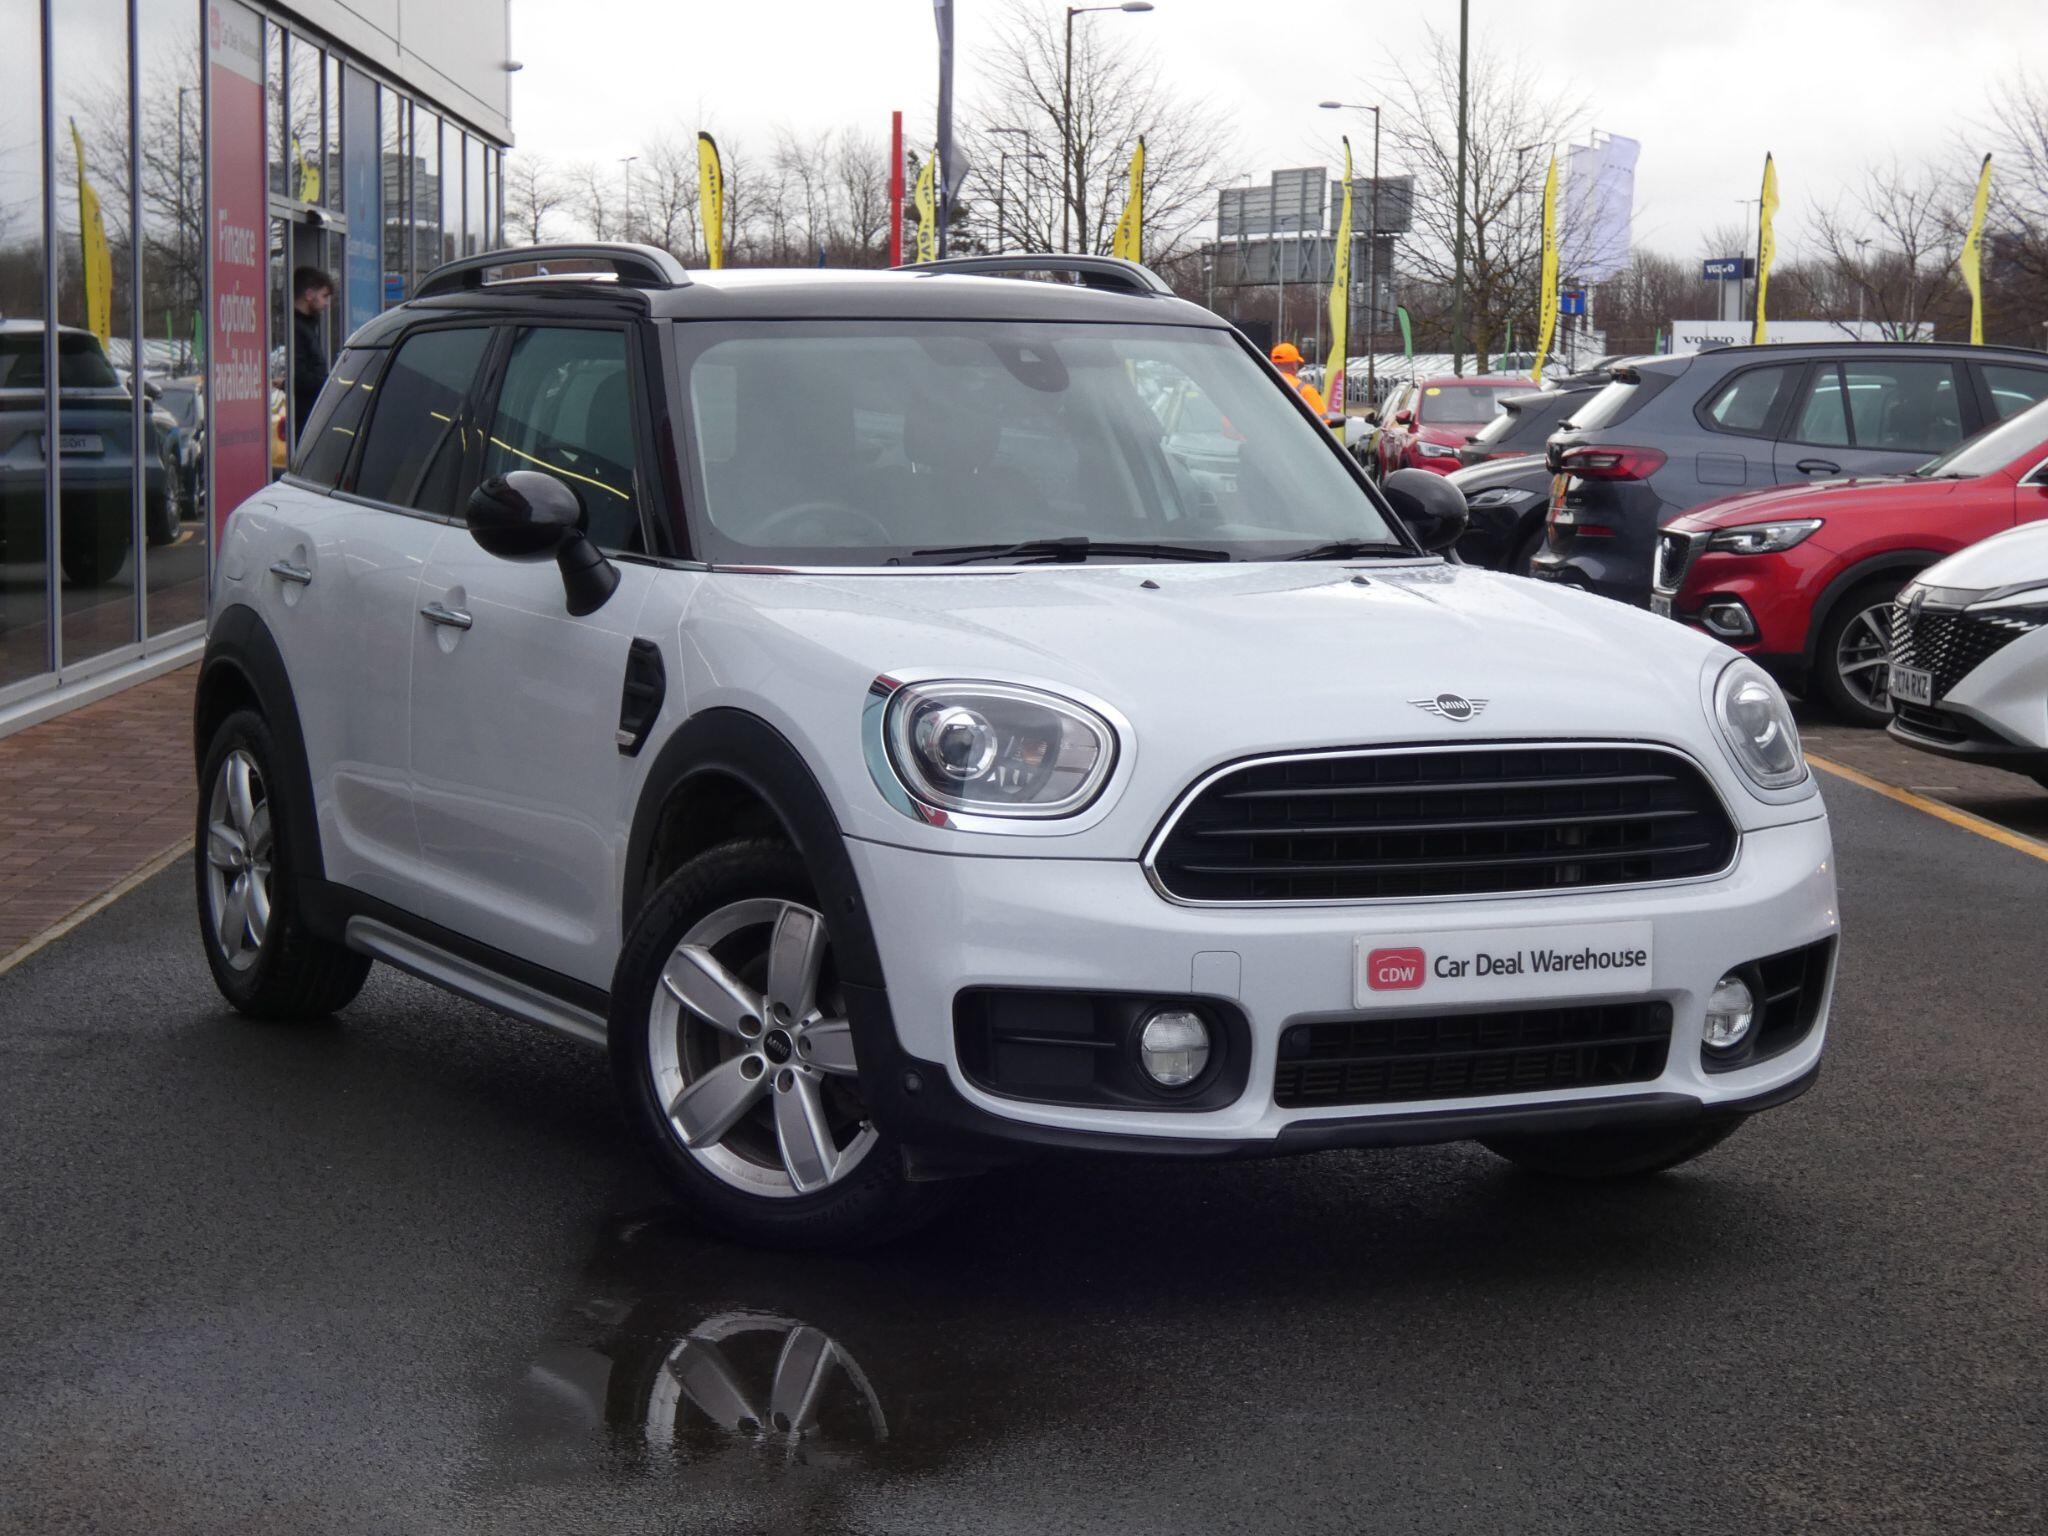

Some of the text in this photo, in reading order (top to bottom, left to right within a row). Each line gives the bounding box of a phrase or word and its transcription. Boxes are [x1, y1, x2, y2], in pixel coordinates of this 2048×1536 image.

[218, 208, 256, 267] Finance
[220, 279, 257, 347] options
[215, 348, 262, 402] available!
[1911, 673, 1928, 699] RXZ
[1439, 701, 1469, 709] MINI
[1378, 947, 1647, 983] CDW Car Deal Warehouse
[767, 1035, 789, 1057] MINI
